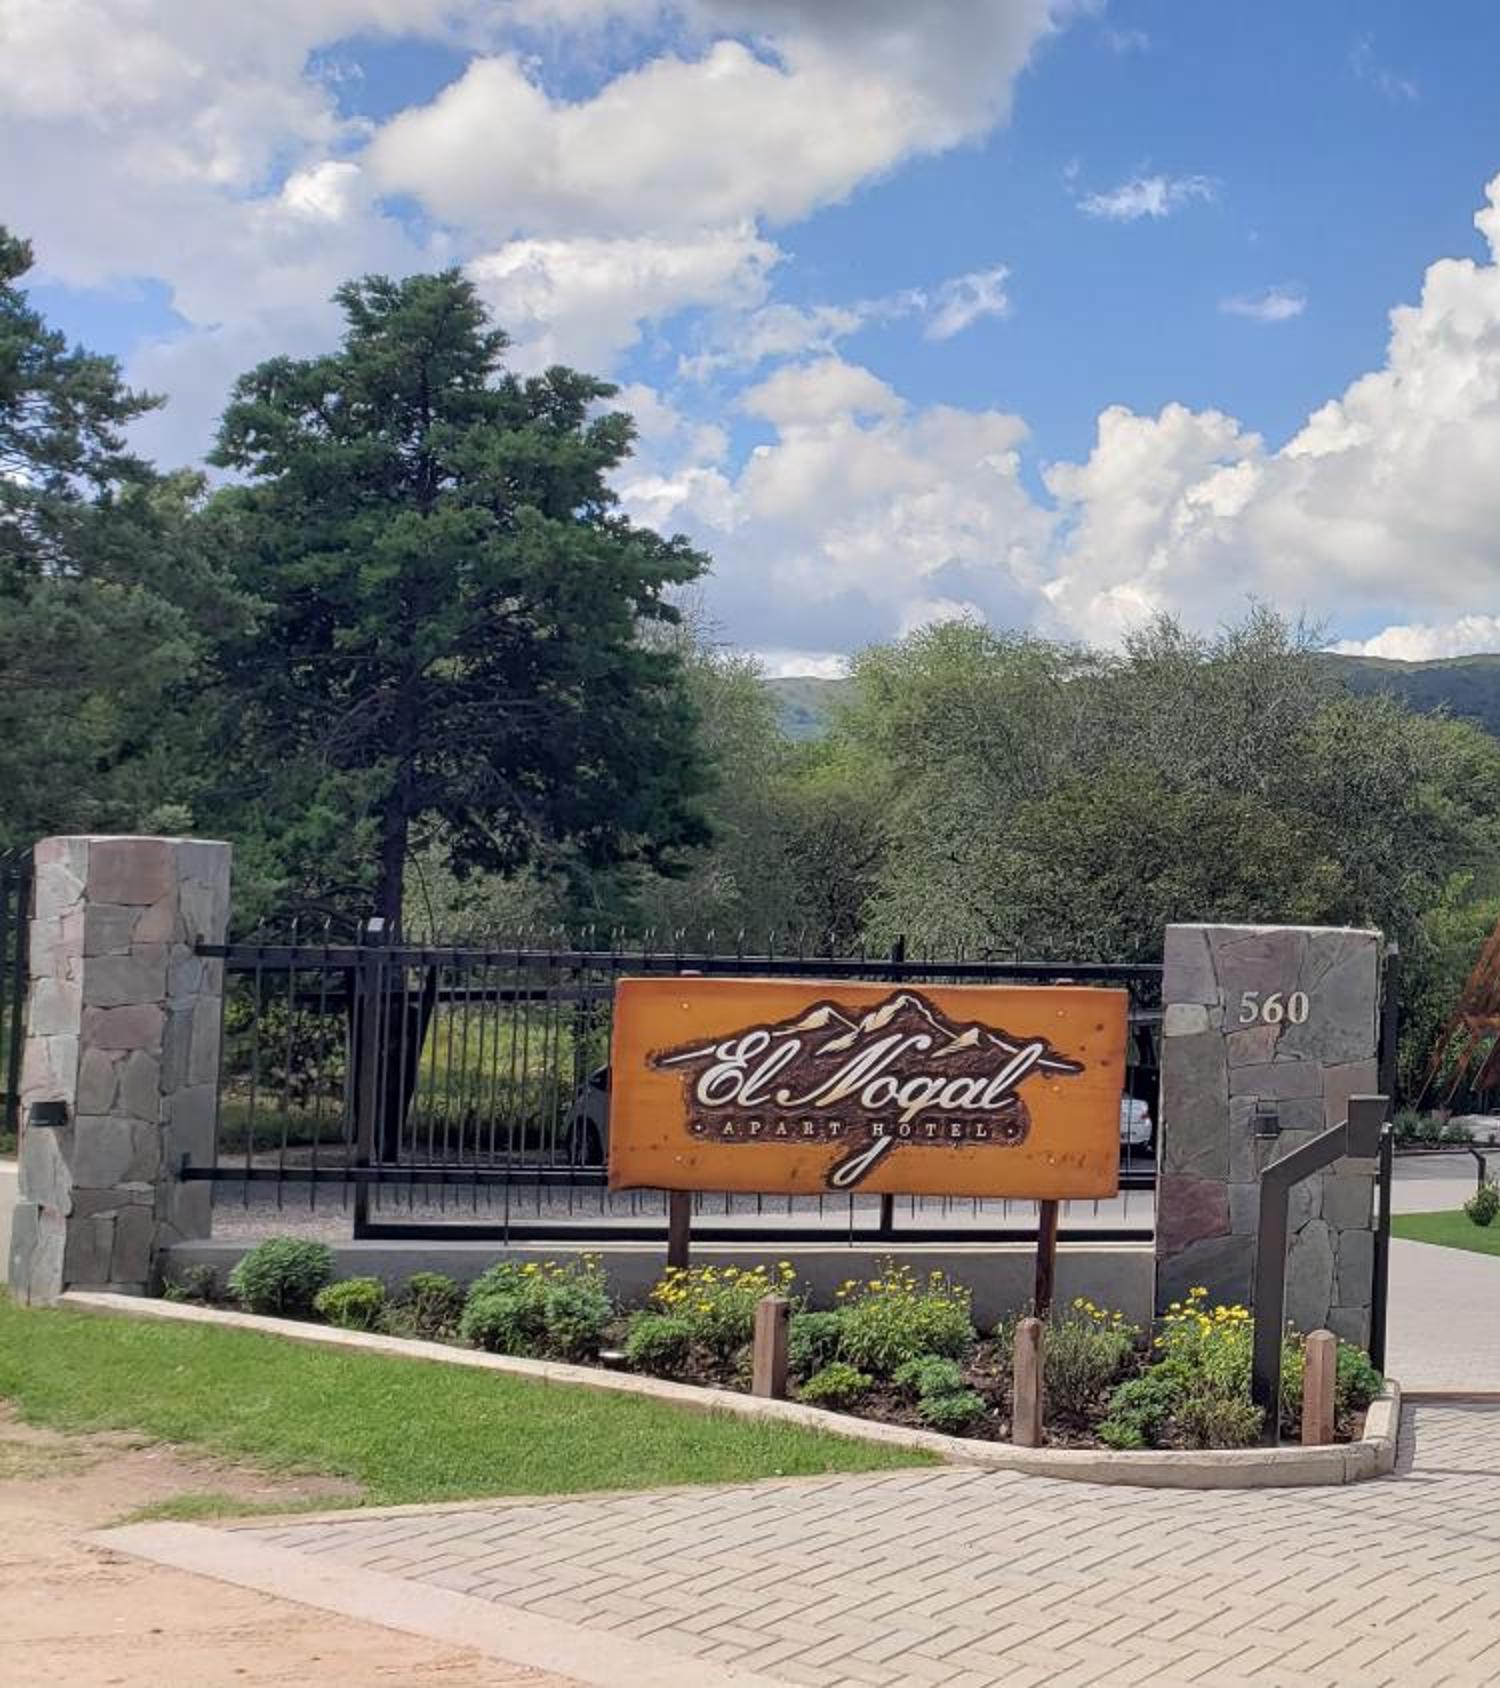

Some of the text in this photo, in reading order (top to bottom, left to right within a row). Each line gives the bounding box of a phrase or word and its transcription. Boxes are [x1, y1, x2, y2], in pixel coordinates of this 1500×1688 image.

[1239, 991, 1310, 1024] 560
[697, 1030, 1043, 1185] El Nogal
[722, 1120, 989, 1138] APART HOTEL
